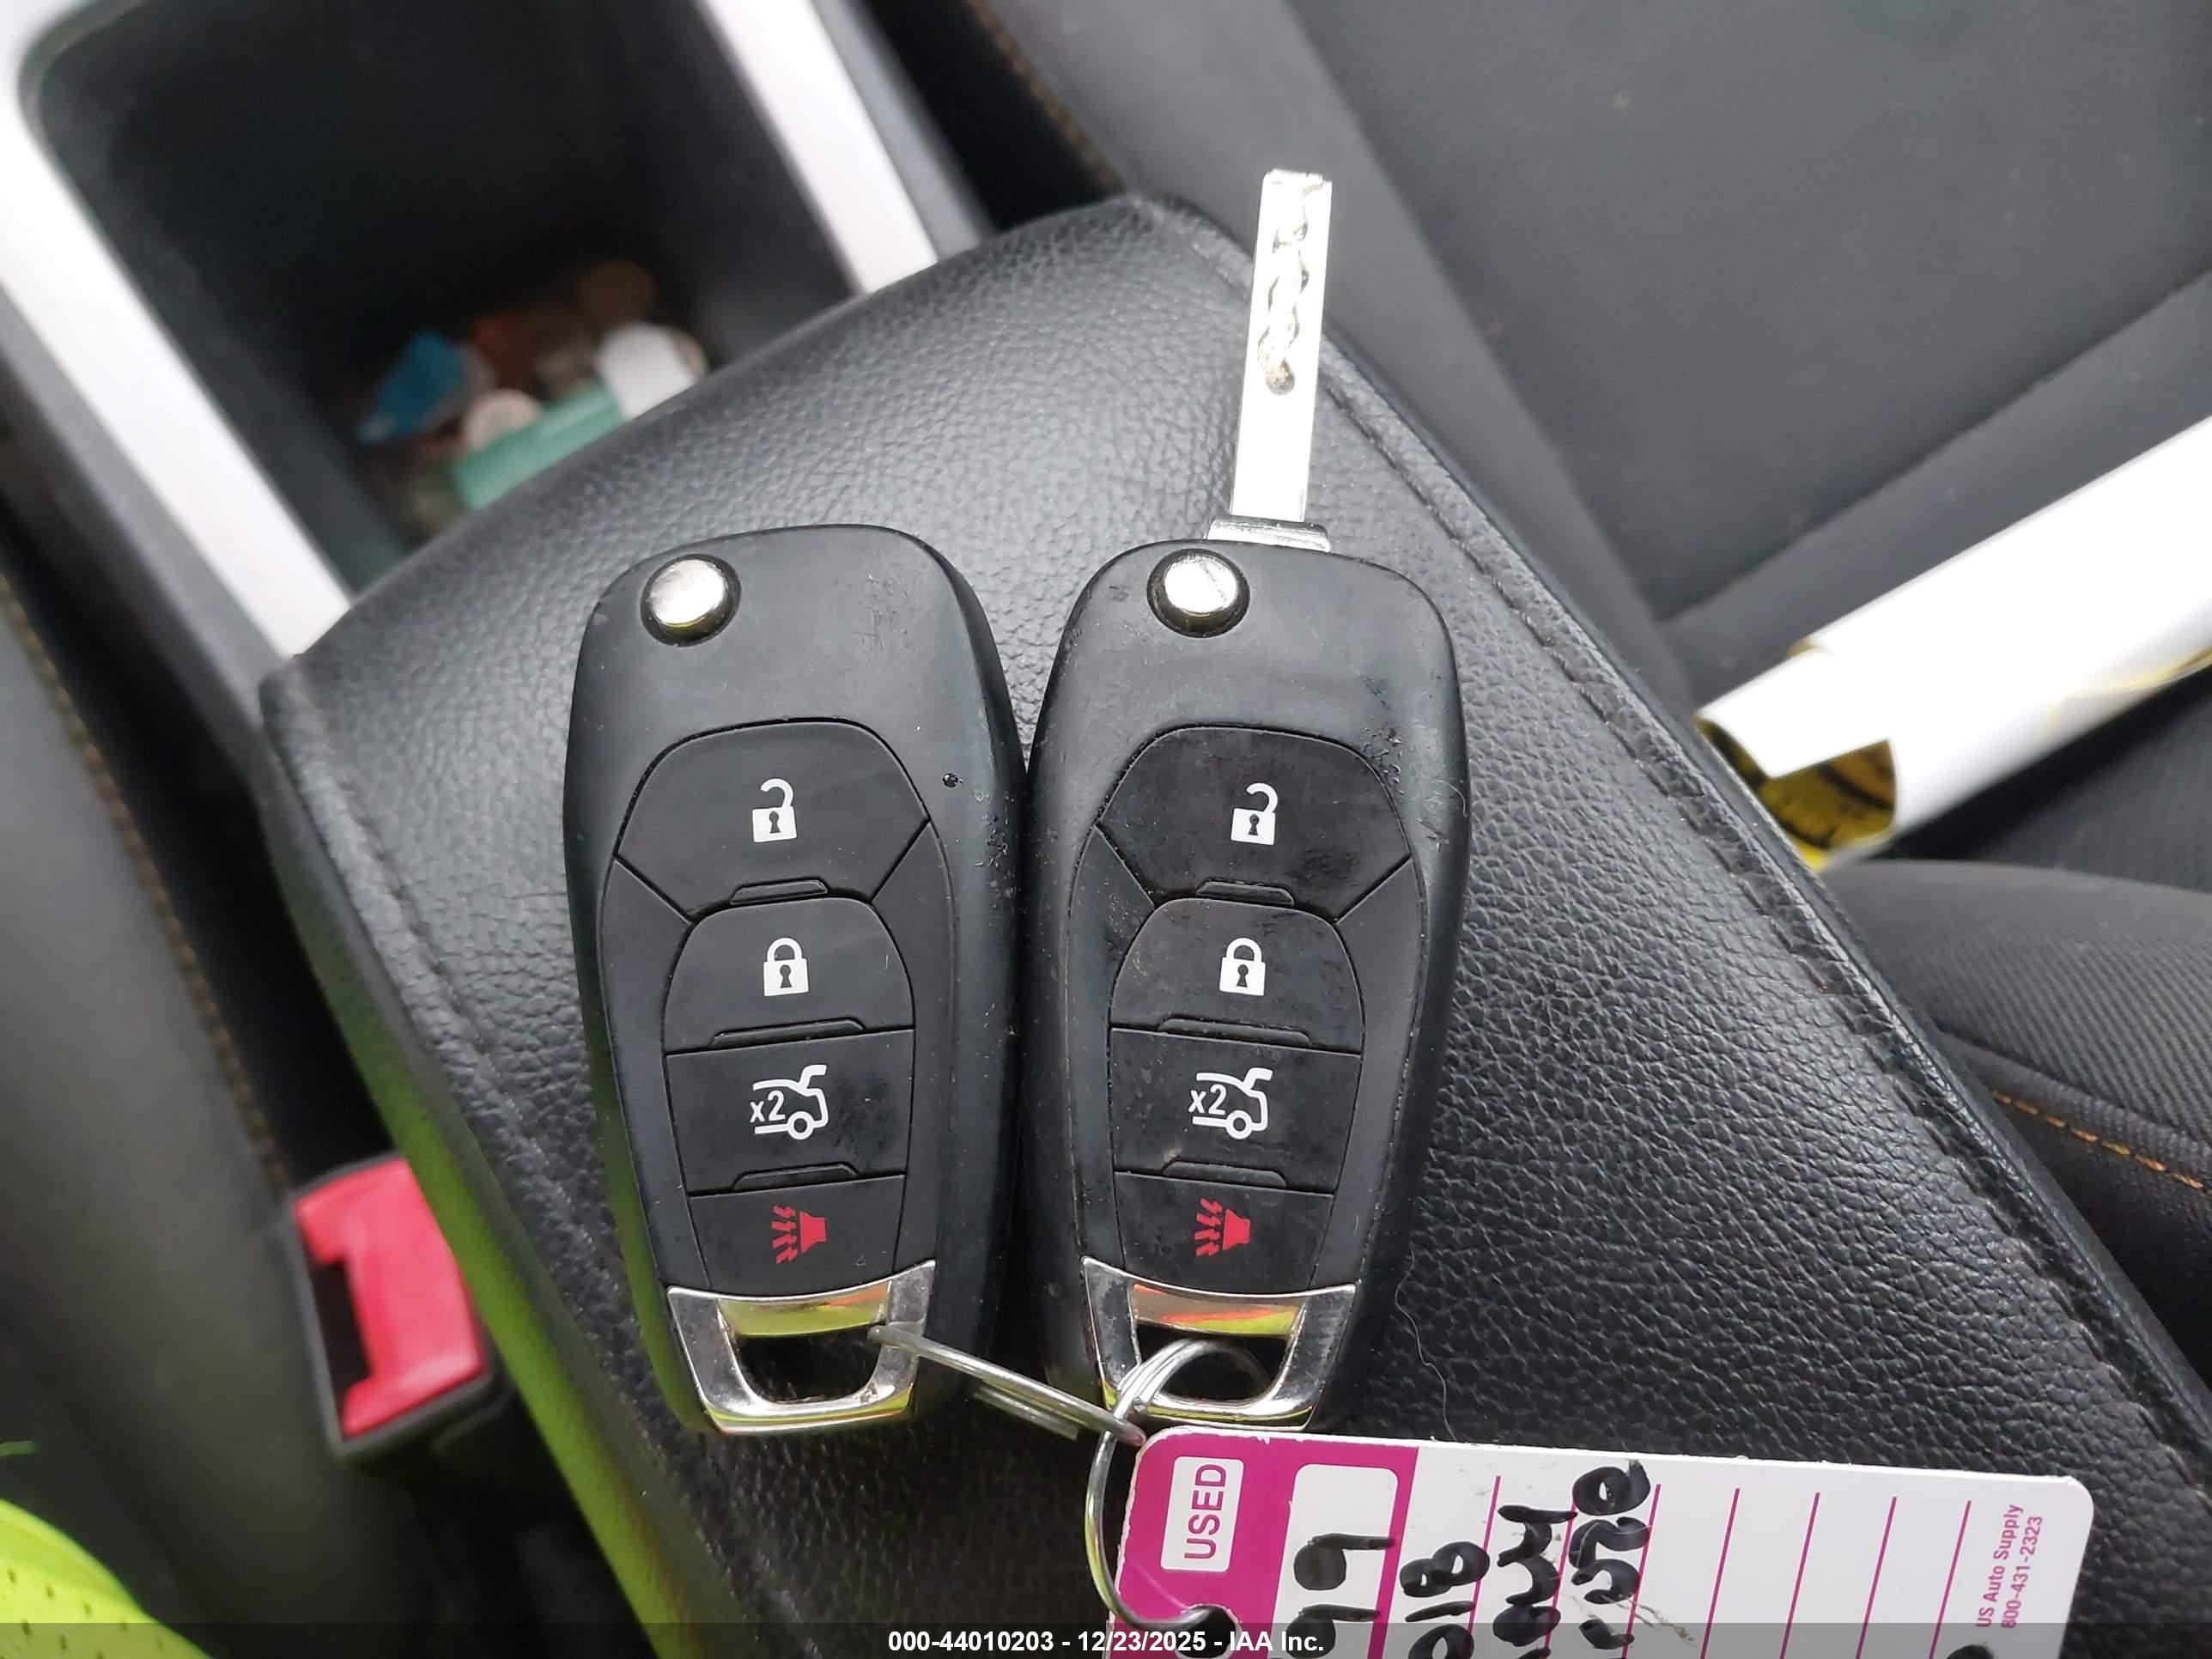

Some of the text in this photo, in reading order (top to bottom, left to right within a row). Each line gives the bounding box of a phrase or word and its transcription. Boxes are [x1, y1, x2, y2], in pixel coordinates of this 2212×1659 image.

[750, 1090, 786, 1122] x2
[1188, 1084, 1226, 1115] x2
[1183, 1463, 1227, 1559] USED
[1975, 1504, 2024, 1628] US Auto Supply
[2001, 1516, 2044, 1629] 800-431-2323
